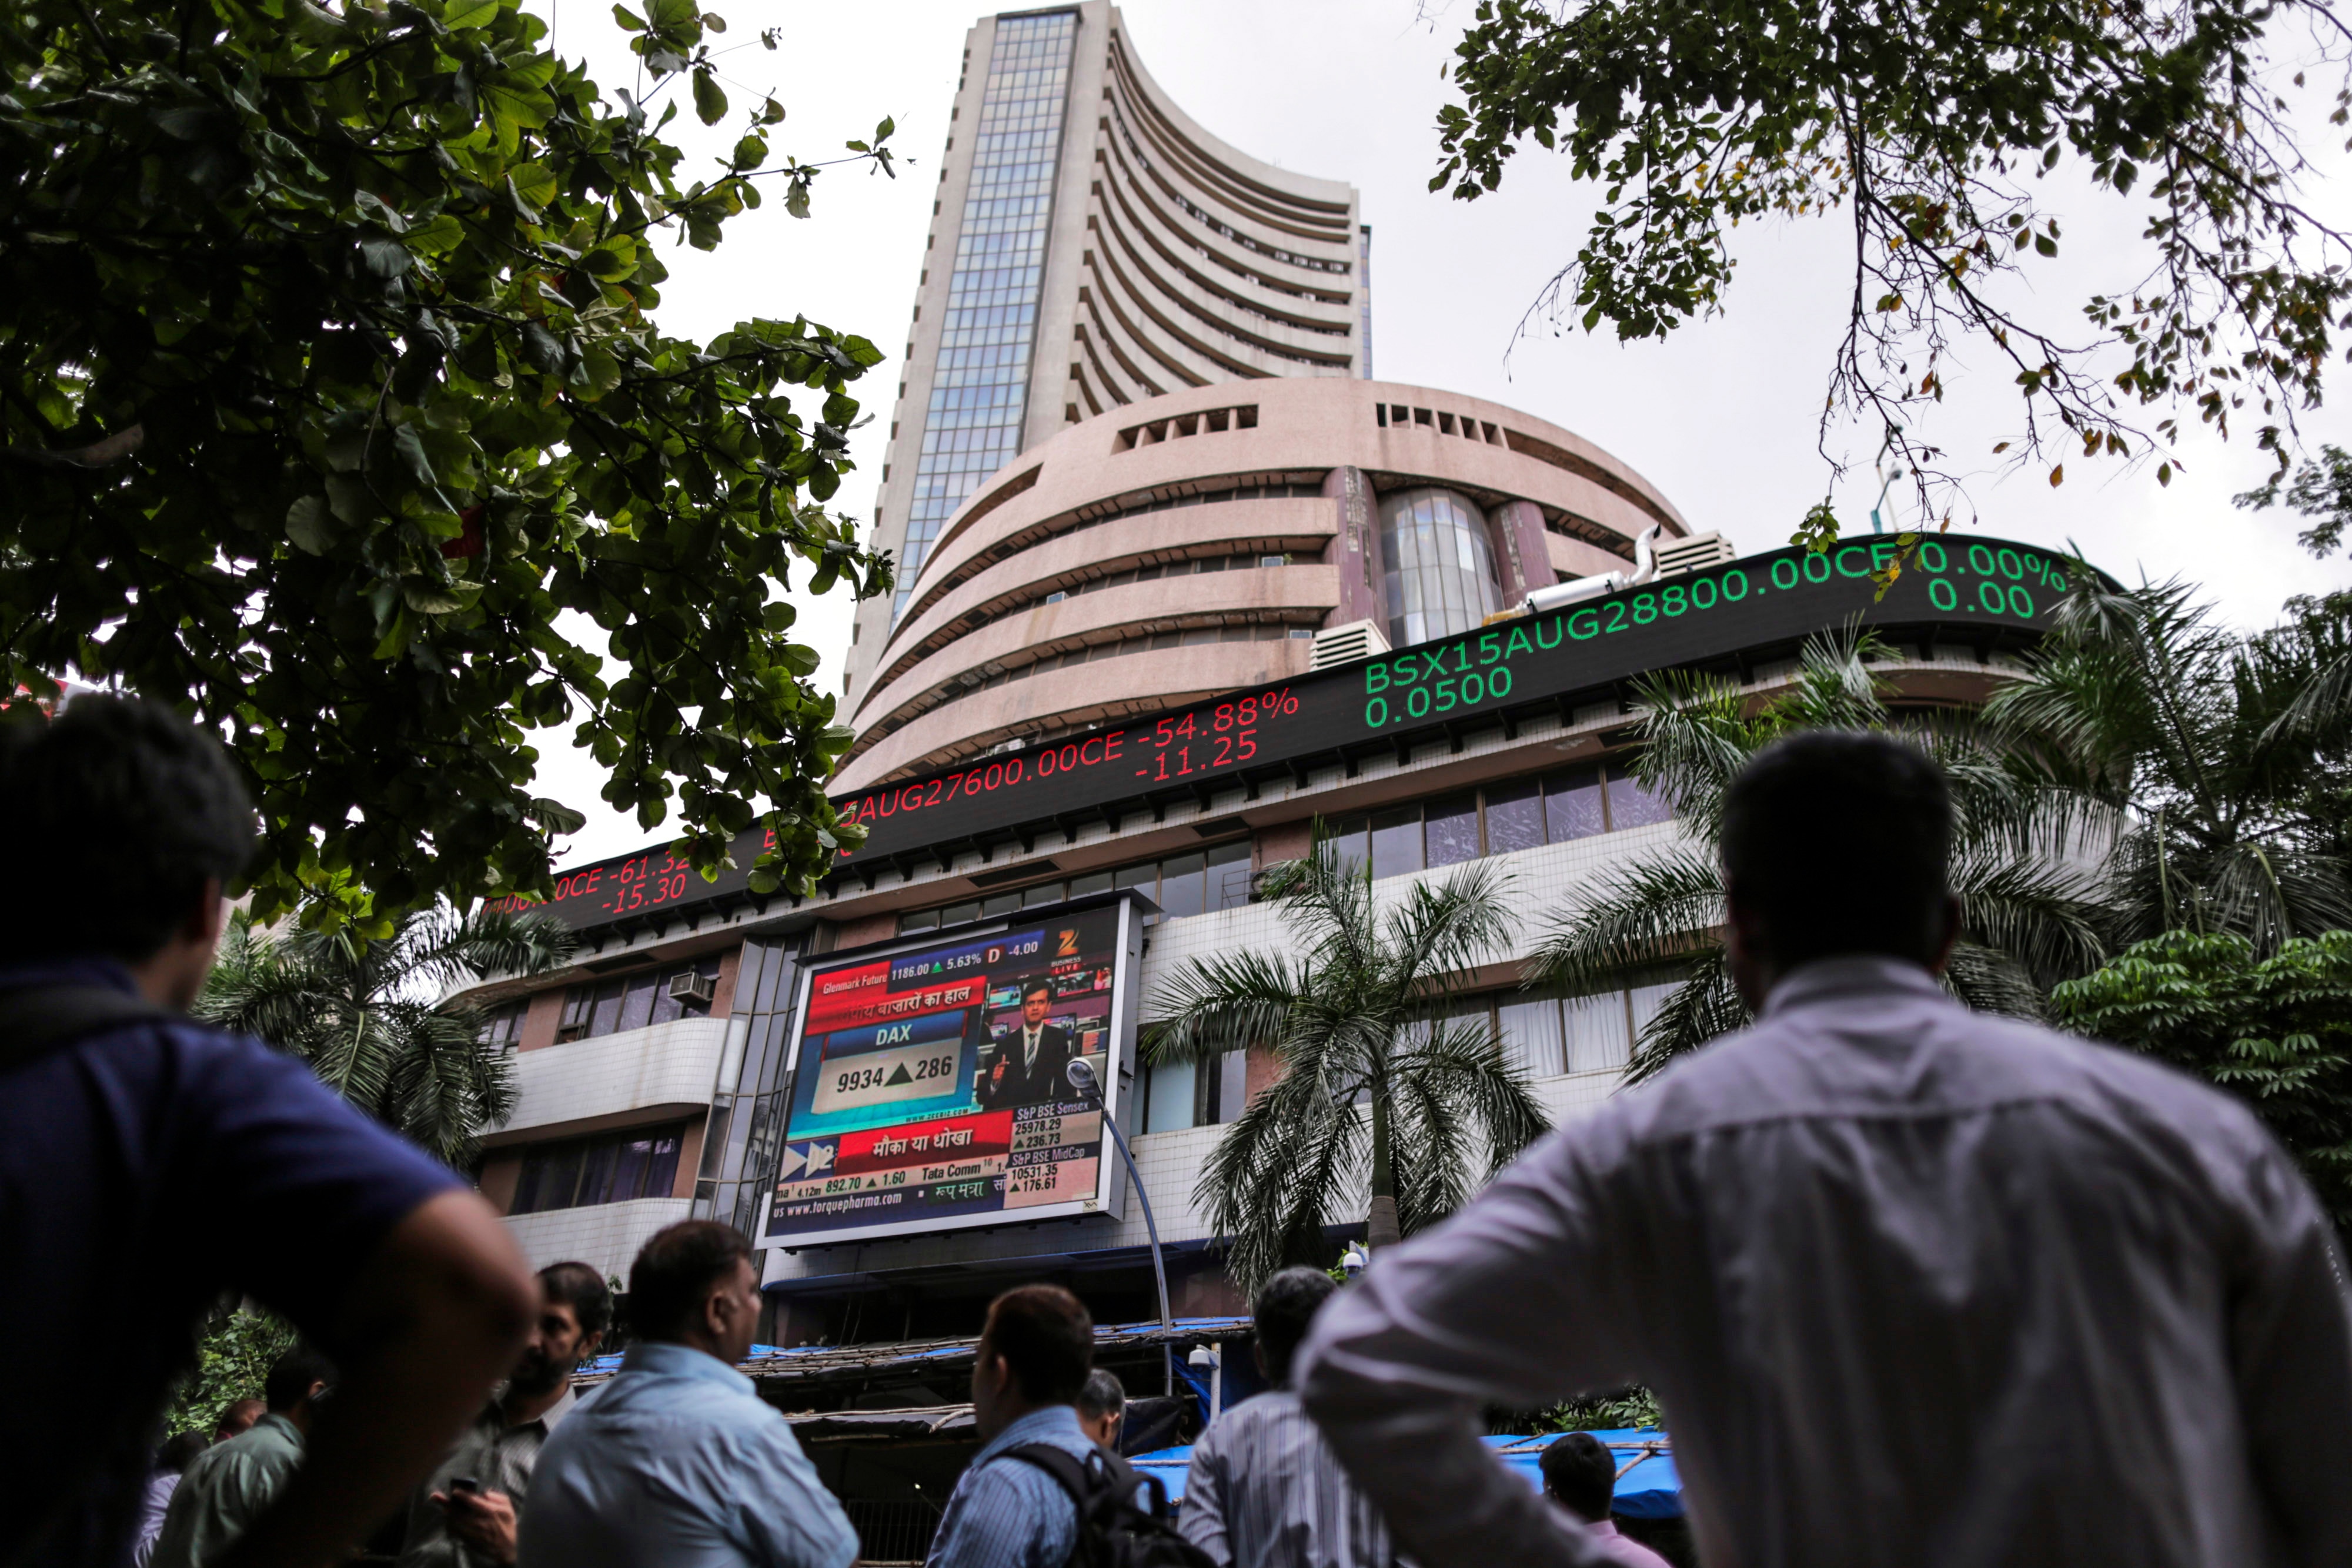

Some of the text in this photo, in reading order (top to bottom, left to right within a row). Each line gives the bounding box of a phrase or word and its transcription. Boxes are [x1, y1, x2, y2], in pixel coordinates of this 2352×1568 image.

[1919, 541, 2066, 591] 0.00%
[1929, 578, 2034, 618] 0.00
[1365, 666, 1512, 728] 0.0500
[1138, 687, 1299, 750] -54.88%
[1135, 728, 1258, 783] -11.25
[602, 873, 686, 914] -15.30
[823, 941, 1038, 994] Glenmark Future 1186.00 5.63% D -4.00
[924, 992, 942, 1007] का
[944, 986, 970, 1003] हाल
[876, 1025, 912, 1046] DAX
[837, 1056, 953, 1092] 9934 286
[1015, 1118, 1061, 1135] 25978.29
[1017, 1102, 1089, 1121] S&P BSE Sensex
[873, 1126, 973, 1156] मौका या धोखा
[1026, 1132, 1061, 1148] 236.73
[1013, 1146, 1085, 1166] S&P BSE MidCap
[797, 1186, 821, 1198] 4.12m
[826, 1177, 861, 1193] 892.70
[883, 1171, 906, 1186] 1.60
[923, 1167, 944, 1181] Tata
[947, 1164, 981, 1178] Comm
[1012, 1164, 1058, 1180] 10531.35
[1024, 1176, 1056, 1192] 176.61
[787, 1193, 902, 1216] www.torquepharma.com
